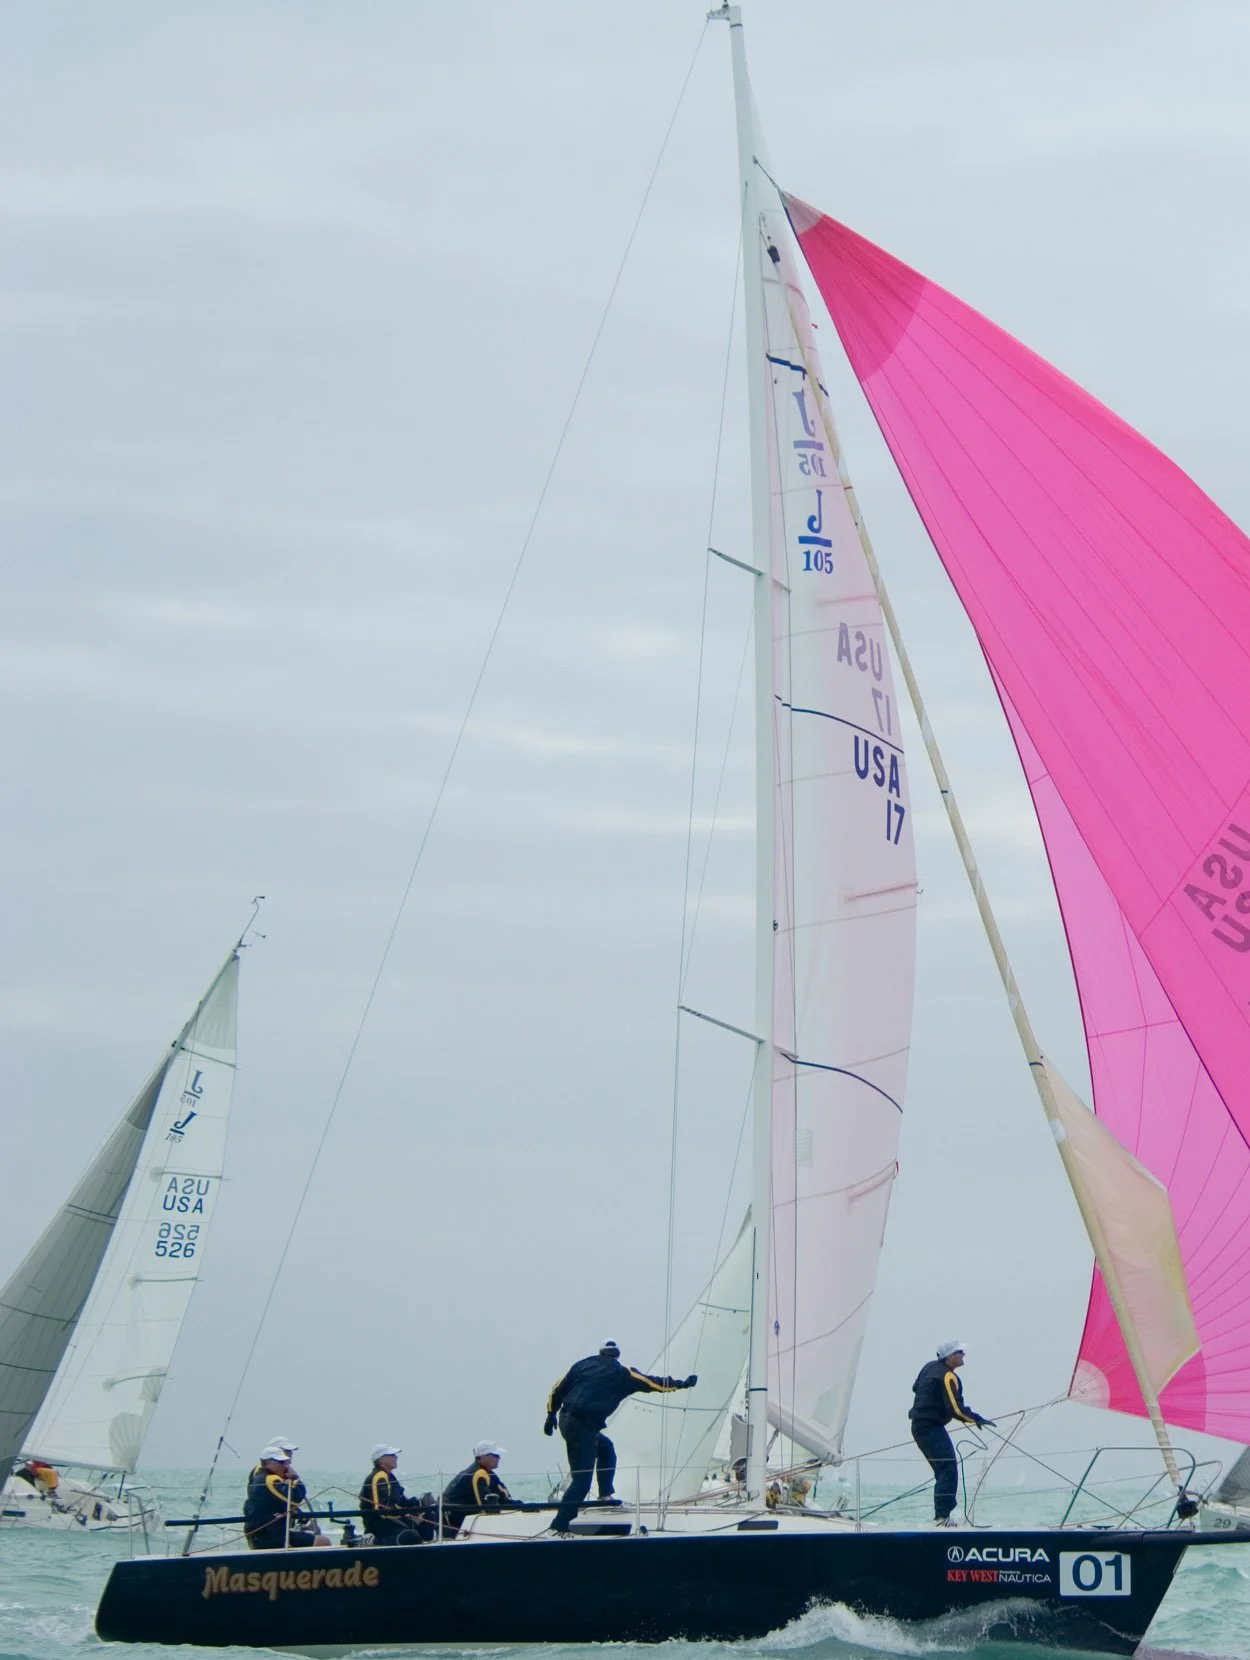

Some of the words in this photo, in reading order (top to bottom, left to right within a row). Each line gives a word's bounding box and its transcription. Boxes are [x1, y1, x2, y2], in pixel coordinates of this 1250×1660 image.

[807, 489, 823, 534] J
[802, 550, 834, 574] 105
[853, 735, 901, 799] USA
[886, 799, 906, 846] 17
[174, 1111, 198, 1129] J
[163, 1194, 204, 1214] USA
[155, 1241, 196, 1258] 526
[964, 1547, 1050, 1562] ACURA
[201, 1560, 380, 1601] Masquerade
[947, 1569, 968, 1582] KEY
[970, 1569, 1000, 1582] WEST
[999, 1574, 1052, 1583] NAUTICA
[1072, 1554, 1123, 1591] 01
